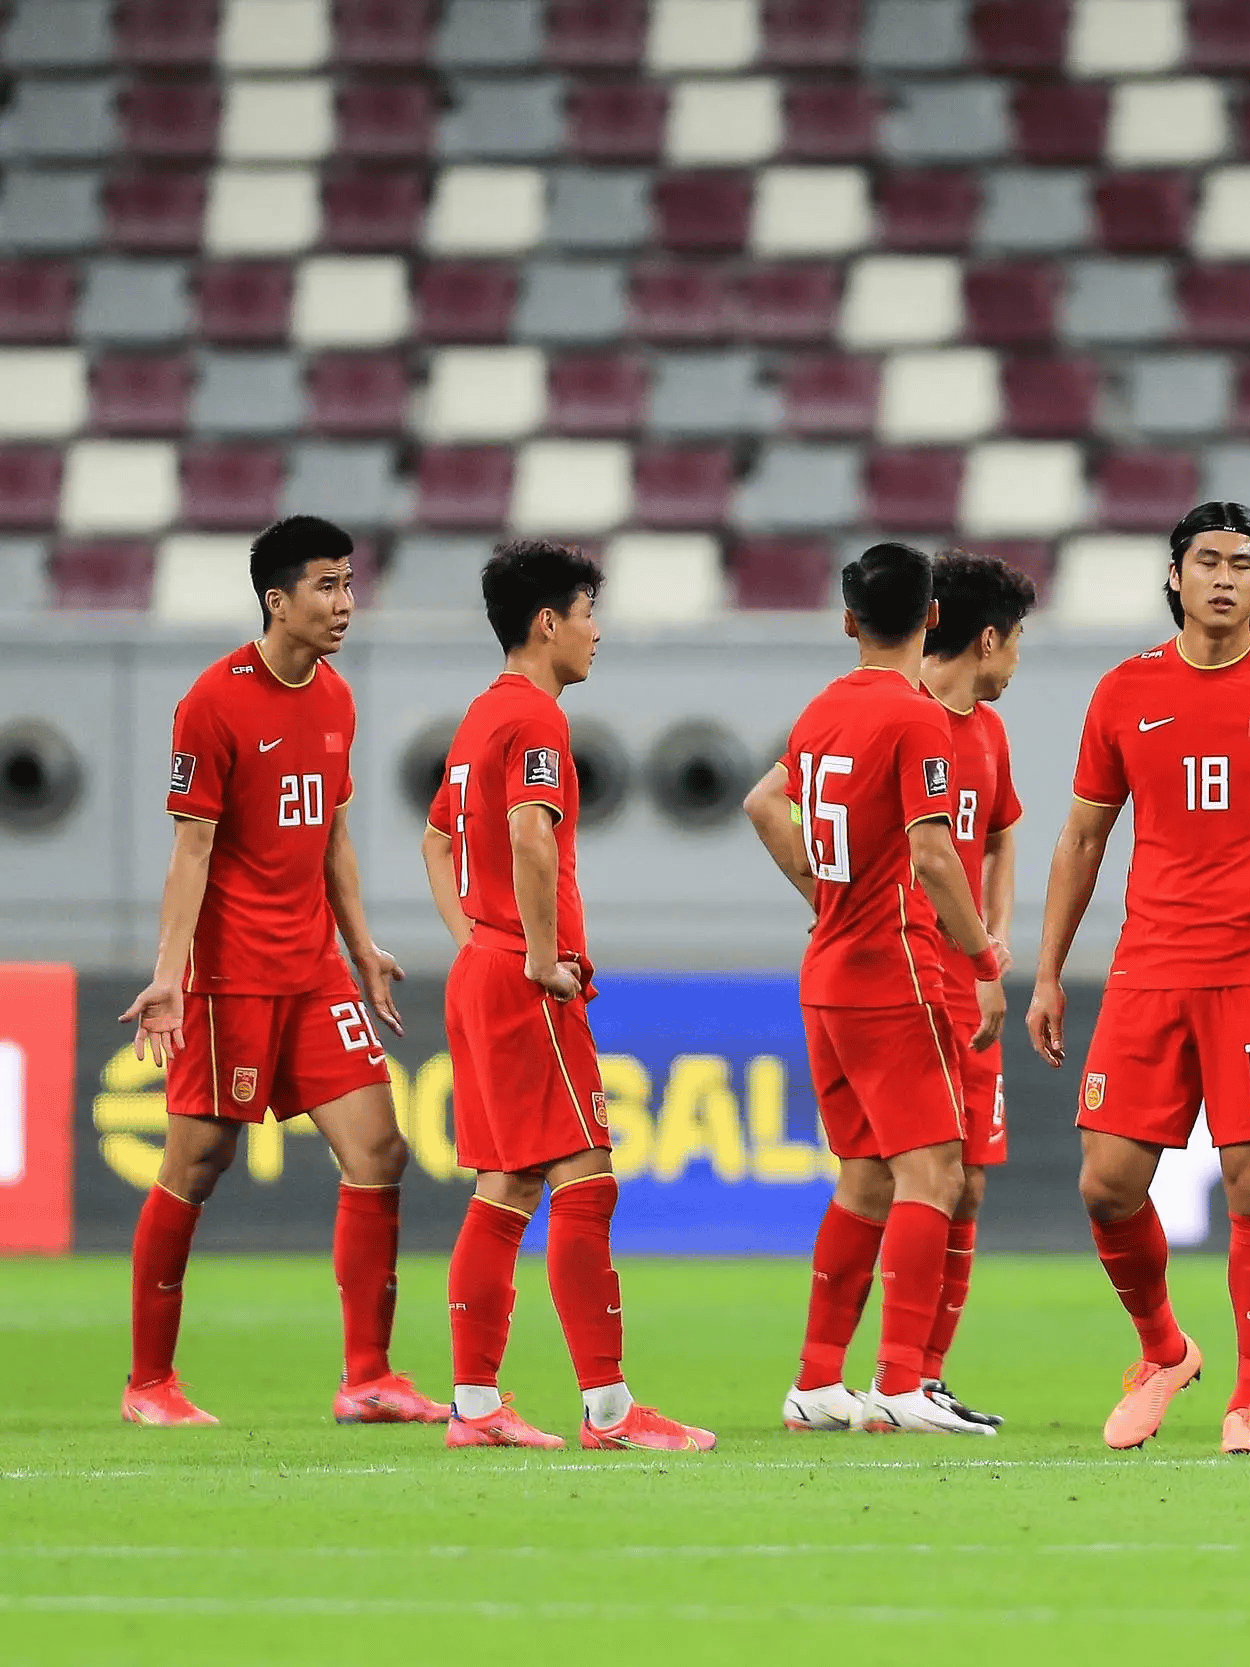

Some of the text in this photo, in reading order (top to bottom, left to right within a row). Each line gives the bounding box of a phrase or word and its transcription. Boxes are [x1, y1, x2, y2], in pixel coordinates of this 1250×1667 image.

[278, 774, 324, 828] 20
[1182, 755, 1230, 812] 18
[800, 752, 854, 883] 15
[956, 789, 978, 841] 8
